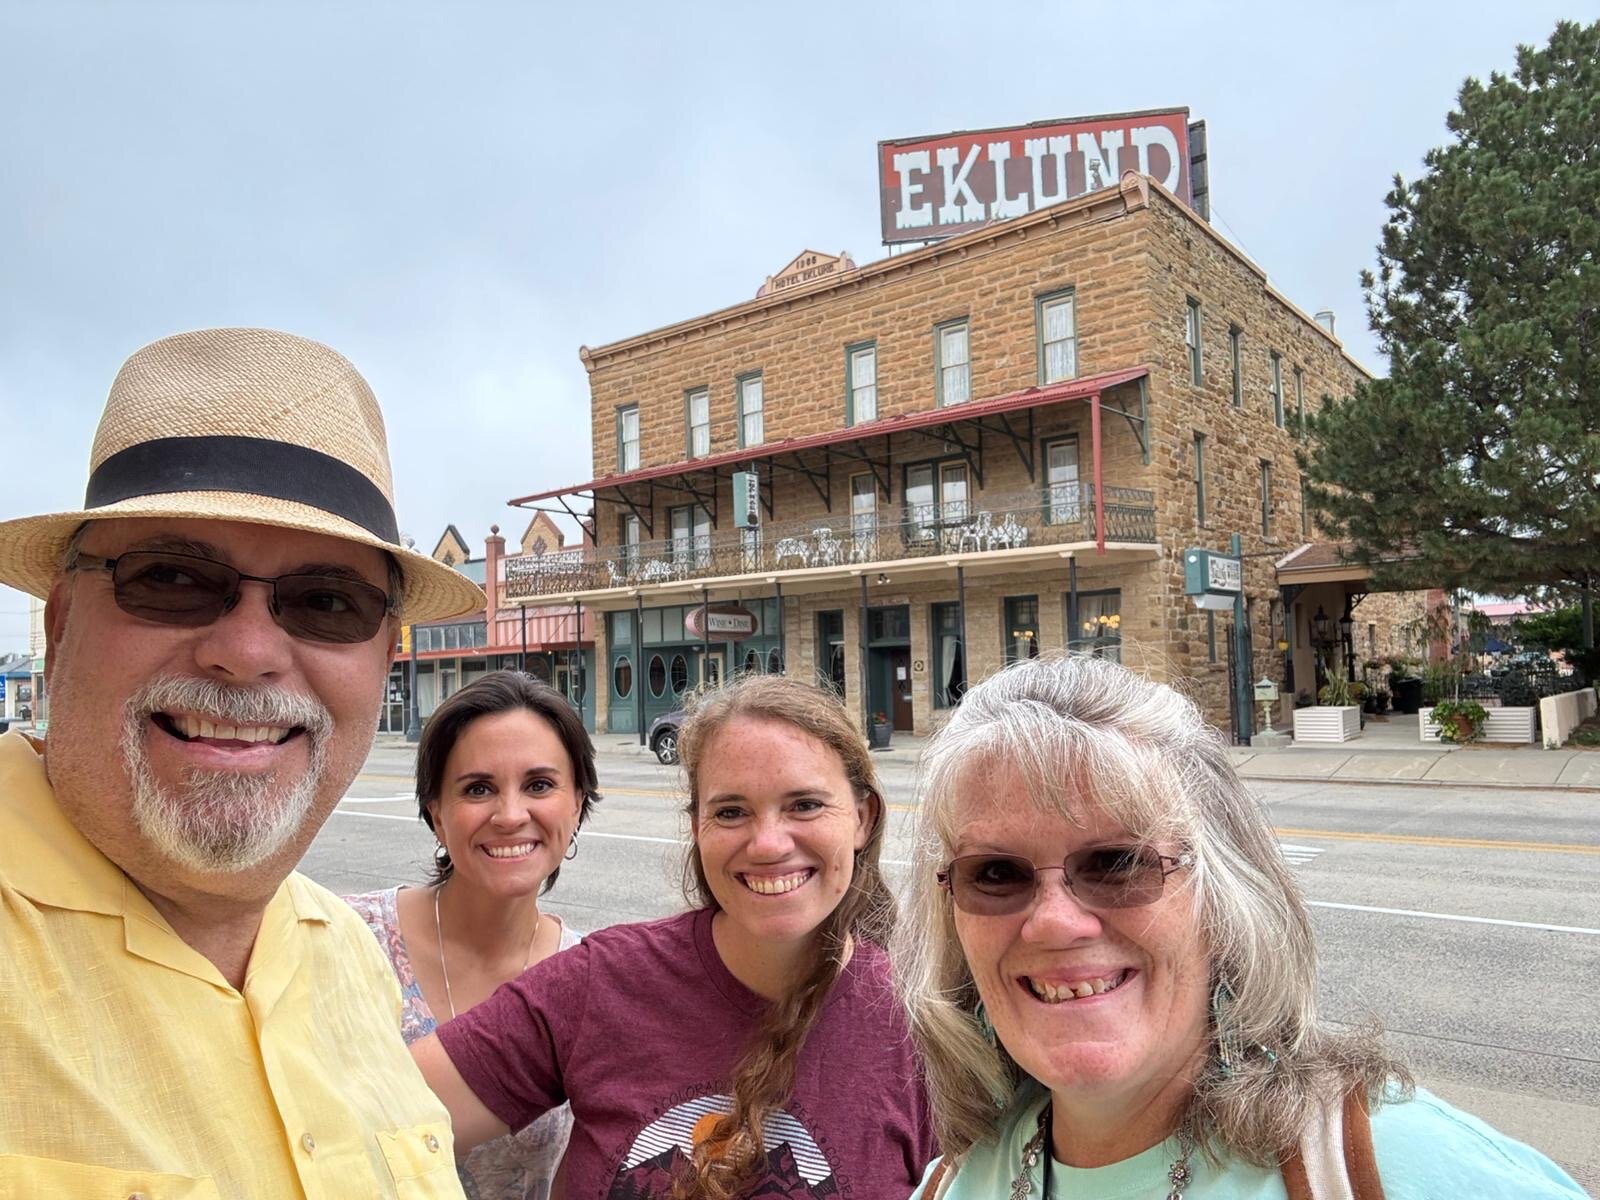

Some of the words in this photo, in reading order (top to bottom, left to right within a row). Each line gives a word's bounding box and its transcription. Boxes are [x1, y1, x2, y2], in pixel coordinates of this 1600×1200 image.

[893, 125, 1181, 229] EKLUND
[775, 275, 801, 290] HOTEL
[803, 264, 834, 281] EKLUND
